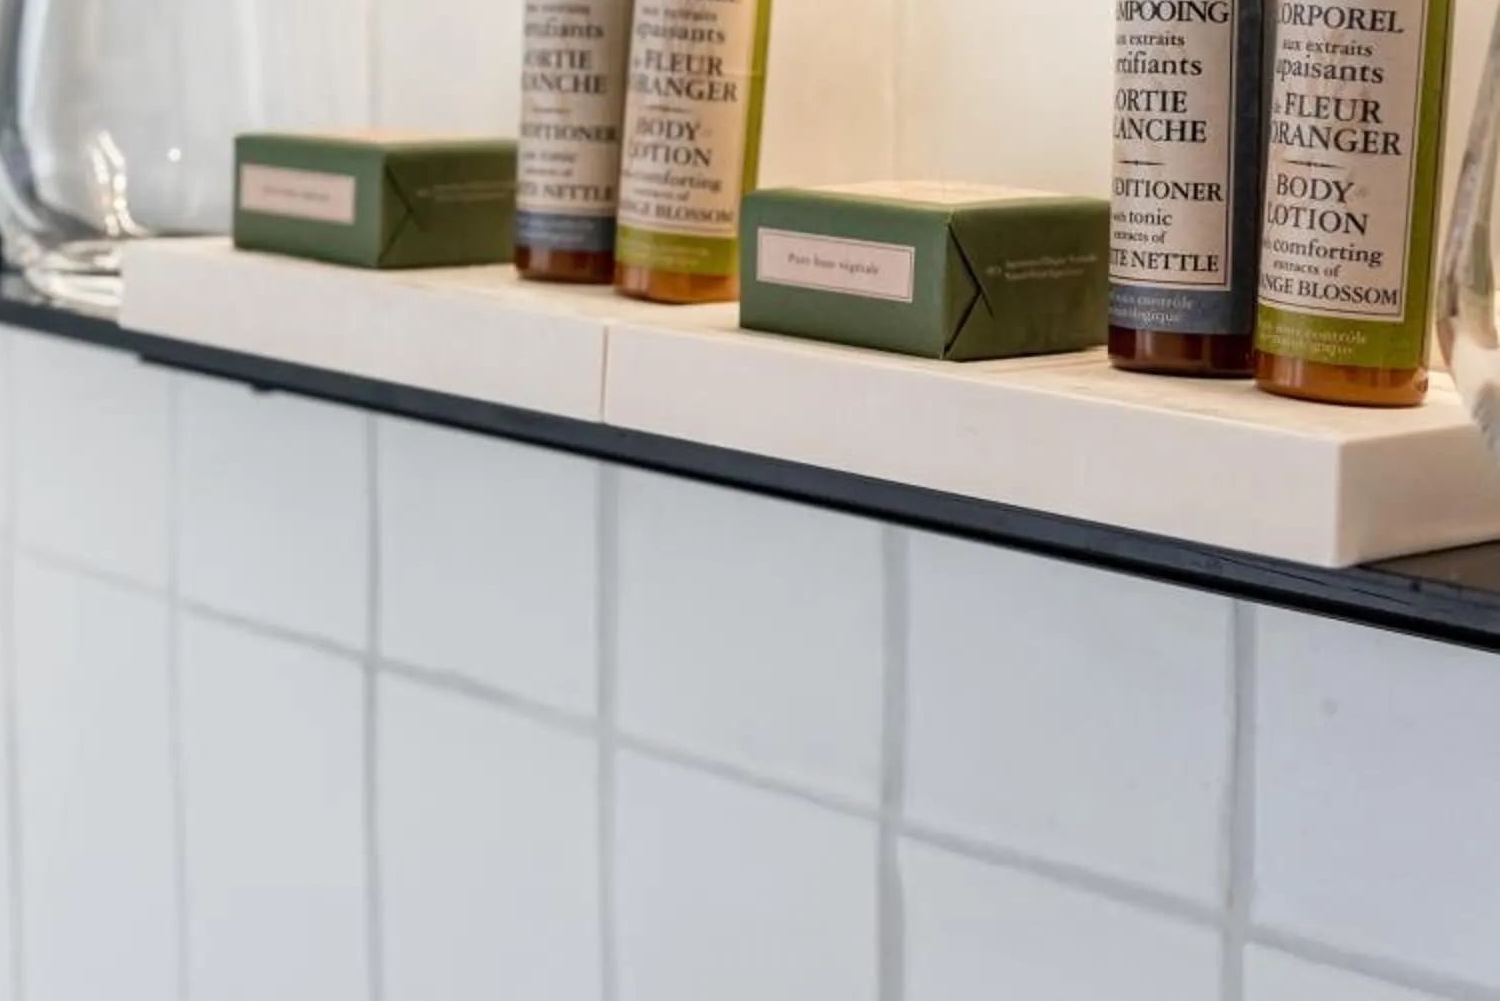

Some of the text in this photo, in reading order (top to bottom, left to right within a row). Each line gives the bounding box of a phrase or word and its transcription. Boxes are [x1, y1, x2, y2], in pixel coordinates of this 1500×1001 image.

[1306, 39, 1374, 58] extraits
[644, 49, 724, 77] FLEUR
[1285, 91, 1384, 125] FLEUR
[636, 116, 702, 142] BODY
[1275, 172, 1356, 204] BODY
[1128, 208, 1173, 227] tonic
[1266, 203, 1369, 236] LOTION
[1131, 250, 1220, 273] NETTLE
[1273, 238, 1385, 269] comforting
[1323, 263, 1343, 279] of
[1298, 278, 1400, 307] BLOSSOM
